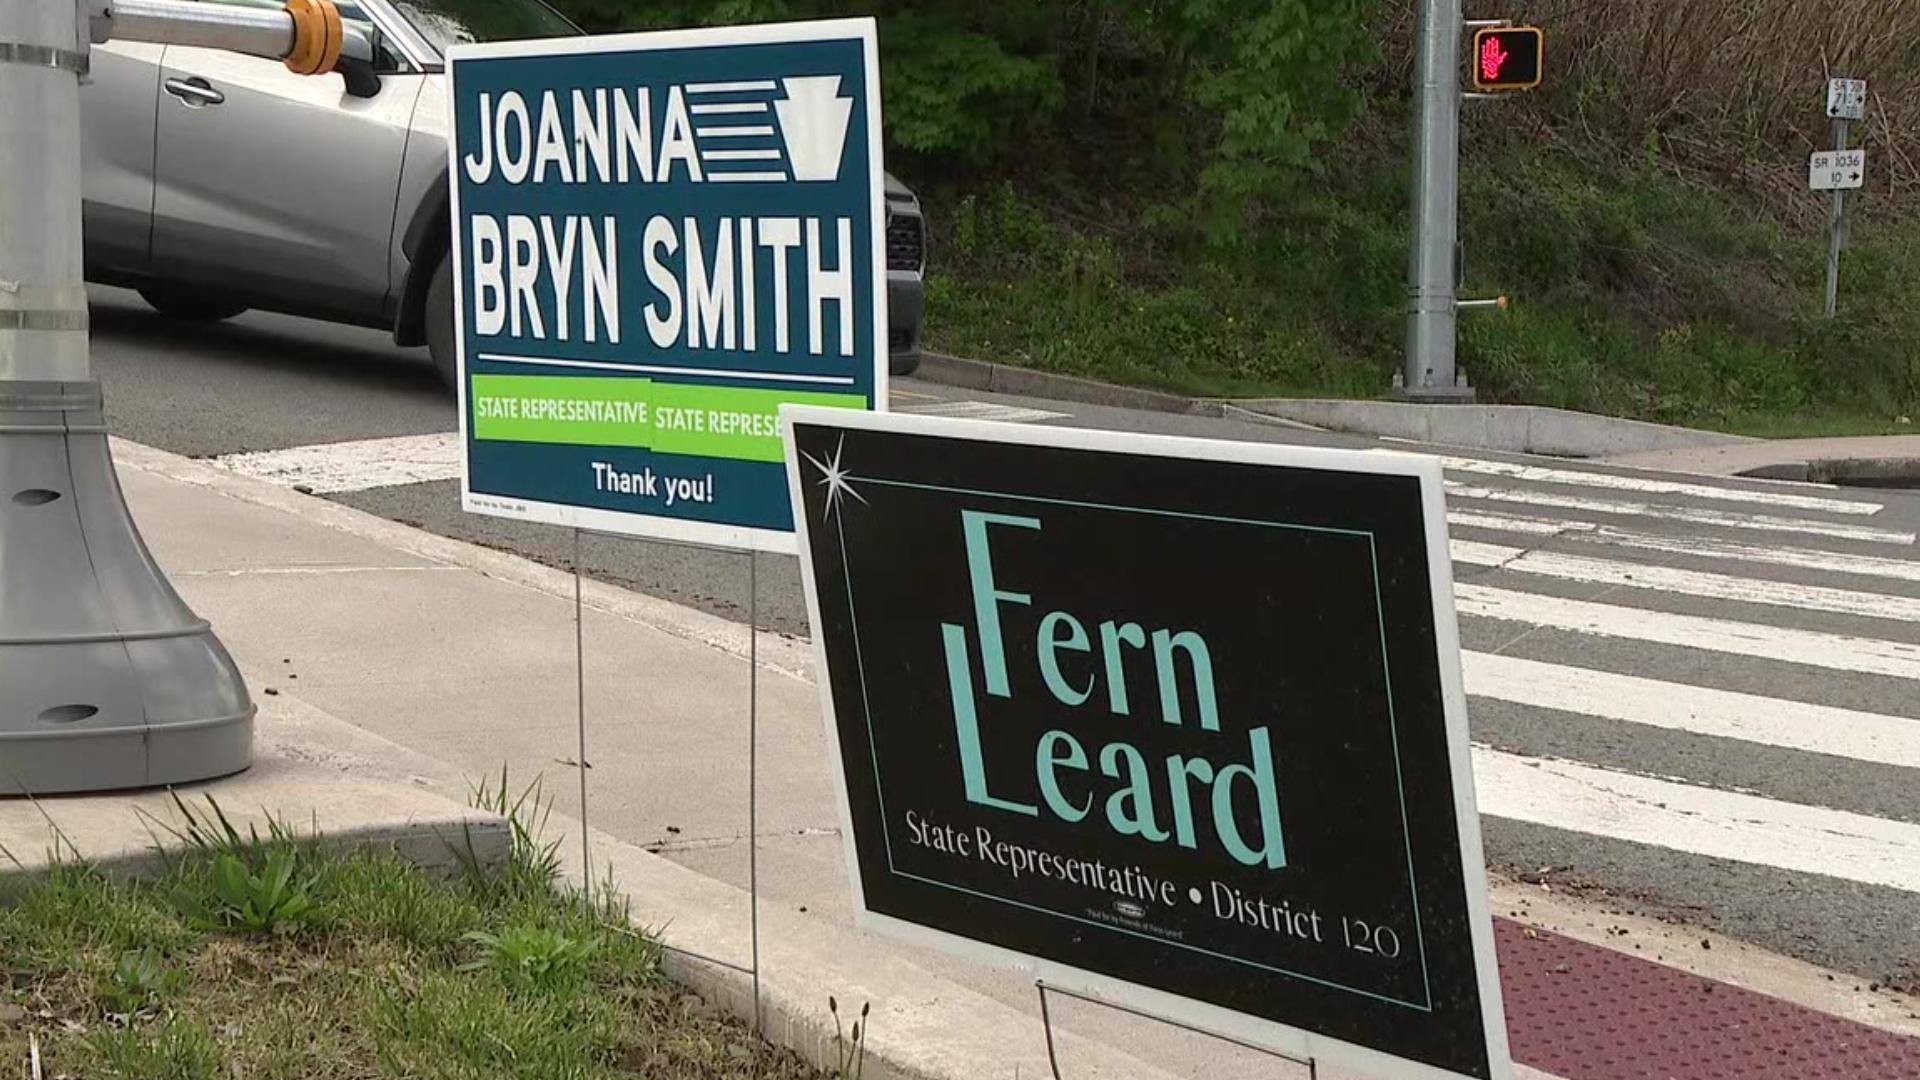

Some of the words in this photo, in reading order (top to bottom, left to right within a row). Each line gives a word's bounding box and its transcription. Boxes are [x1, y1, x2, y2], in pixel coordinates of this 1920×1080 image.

[464, 84, 703, 185] JOANNA
[1814, 157, 1828, 169] SR
[1834, 155, 1860, 168] 1036
[1831, 171, 1843, 183] 10
[471, 214, 619, 344] BRYN
[642, 215, 854, 357] SMITH
[478, 397, 518, 418] STATE
[521, 398, 648, 424] REPRESENTATIVE
[655, 406, 704, 432] STATE
[592, 462, 657, 496] Thank
[664, 474, 713, 506] you!
[961, 509, 1221, 732] Fern
[941, 622, 1288, 870] Leard
[906, 809, 971, 857] State
[976, 826, 1176, 906] Representative
[1211, 880, 1323, 943] District
[1342, 916, 1400, 959] 120
